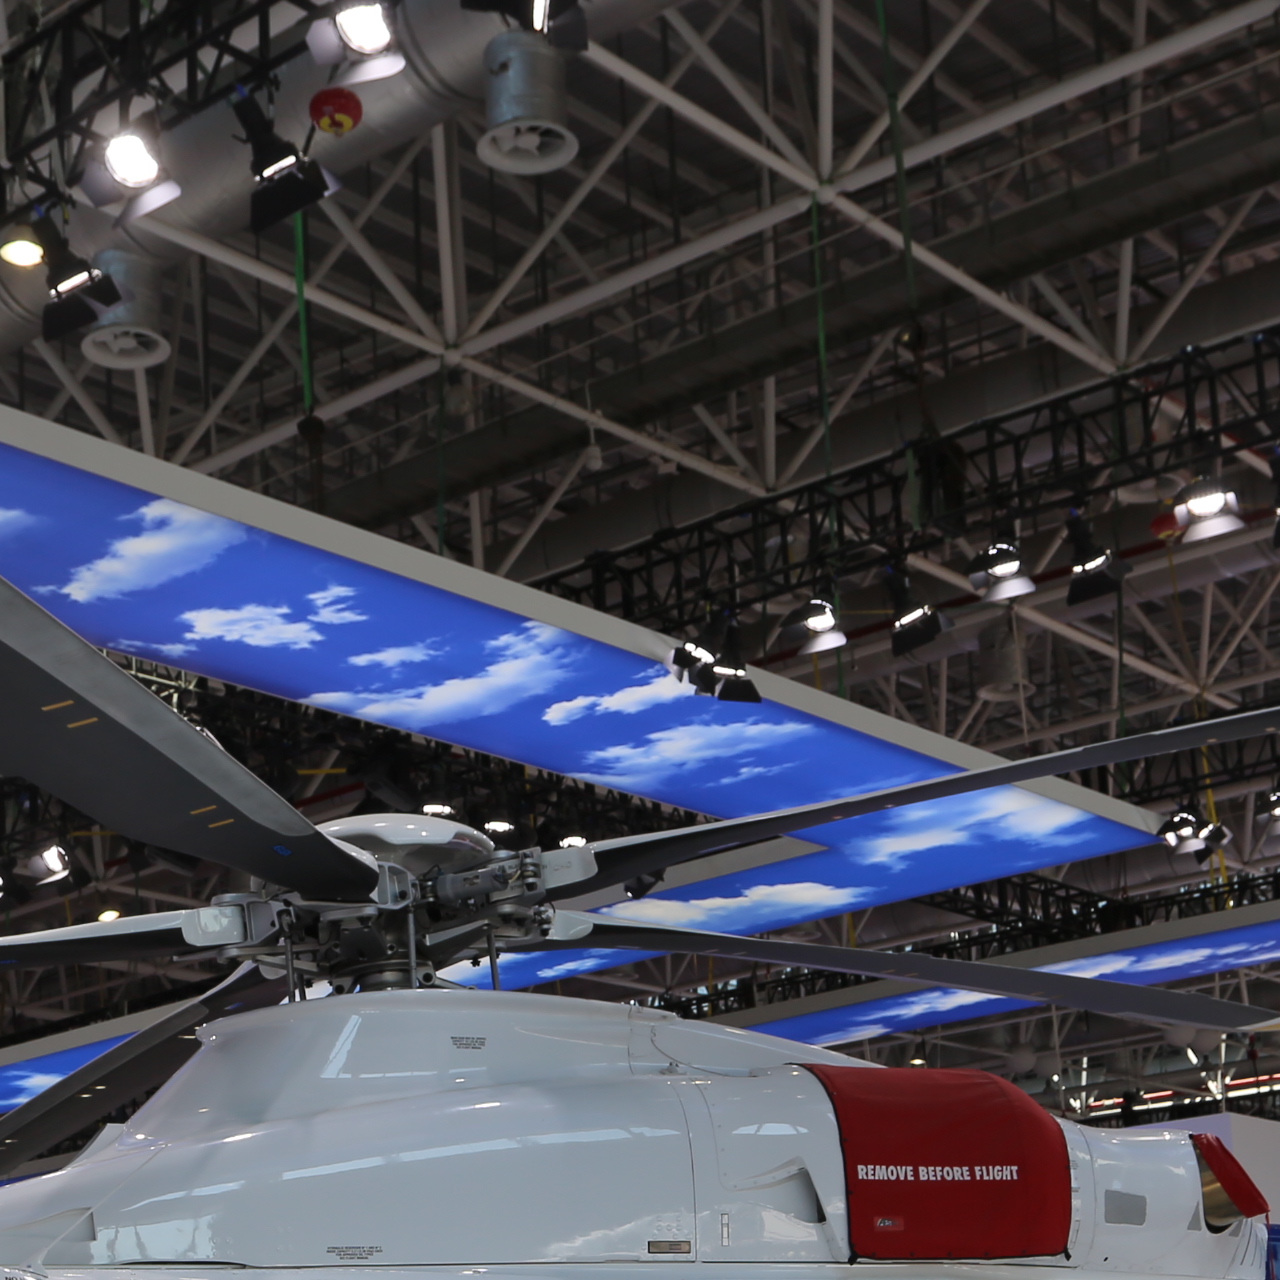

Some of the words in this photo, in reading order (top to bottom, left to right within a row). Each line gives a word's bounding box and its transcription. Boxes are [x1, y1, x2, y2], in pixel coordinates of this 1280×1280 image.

[857, 1165, 915, 1181] REMOVE
[919, 1165, 971, 1181] BEFORE
[974, 1165, 1019, 1181] FLIGHT
